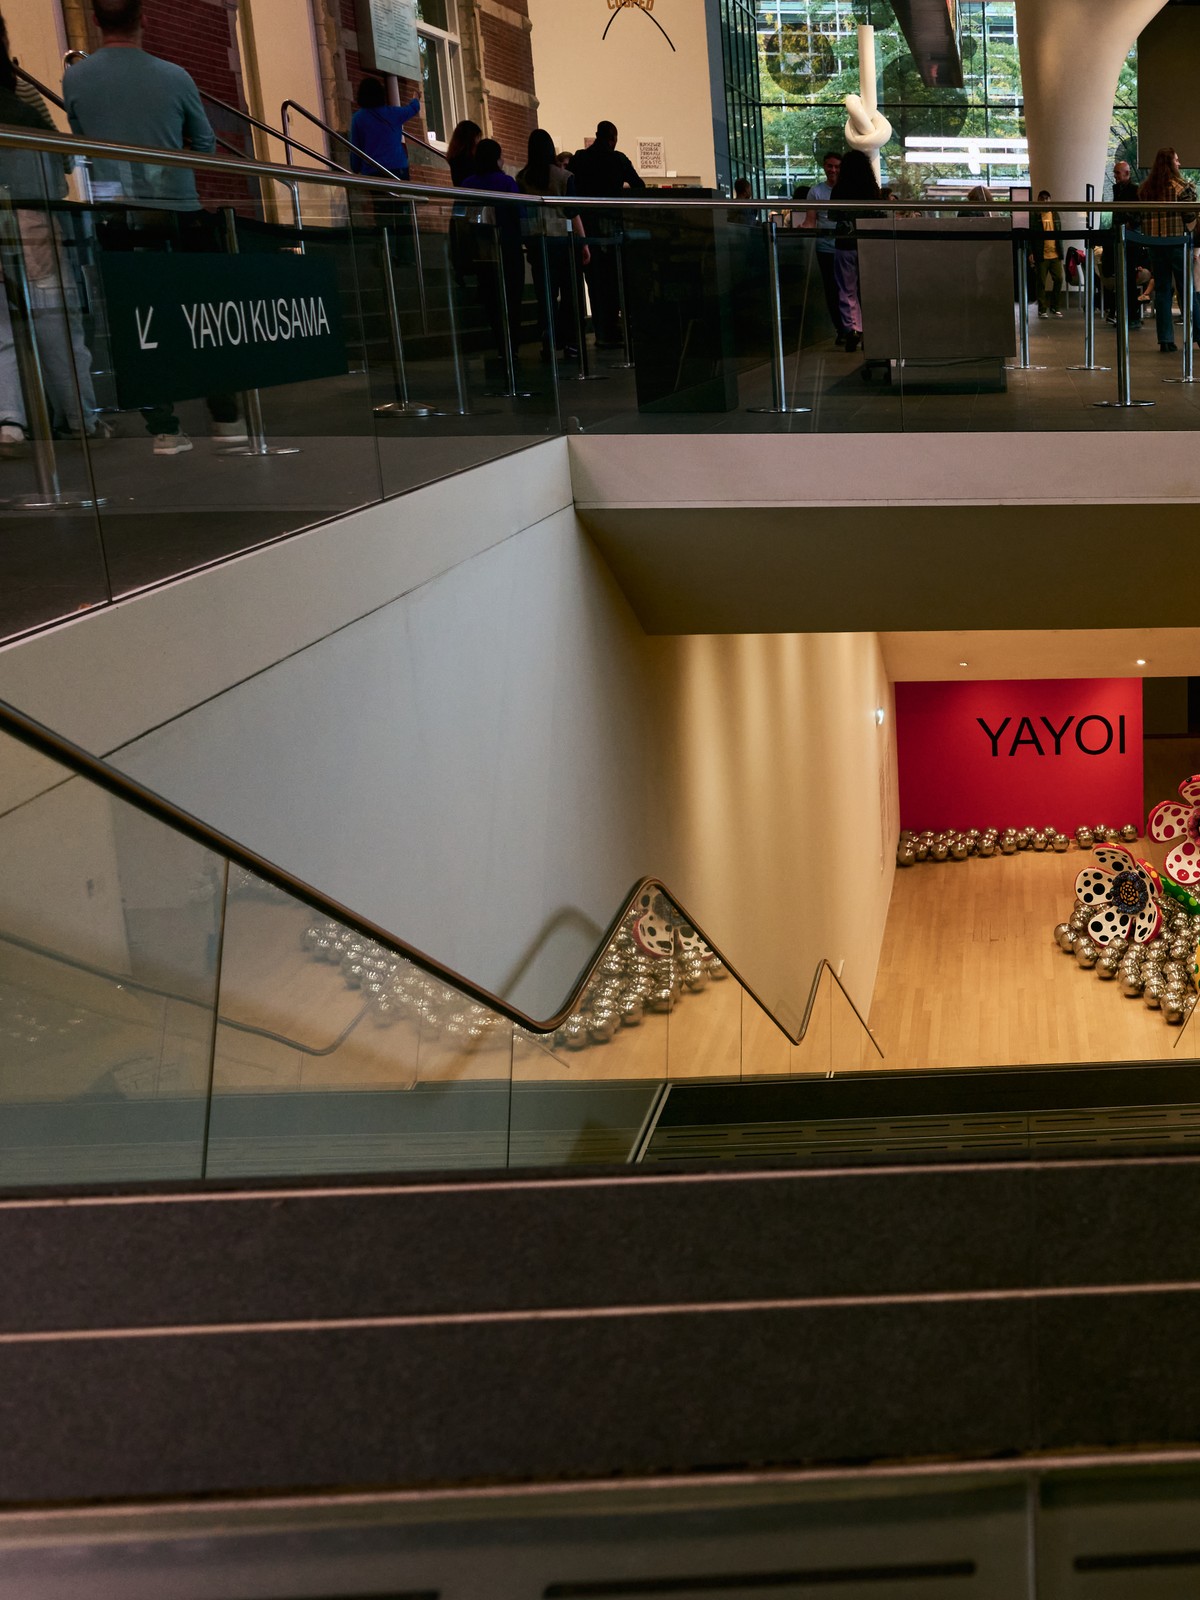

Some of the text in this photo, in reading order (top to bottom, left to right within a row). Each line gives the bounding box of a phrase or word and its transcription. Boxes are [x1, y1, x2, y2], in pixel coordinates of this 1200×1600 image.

[181, 296, 330, 349] YAYOI KUSAMA
[977, 715, 1125, 757] YAYOI
